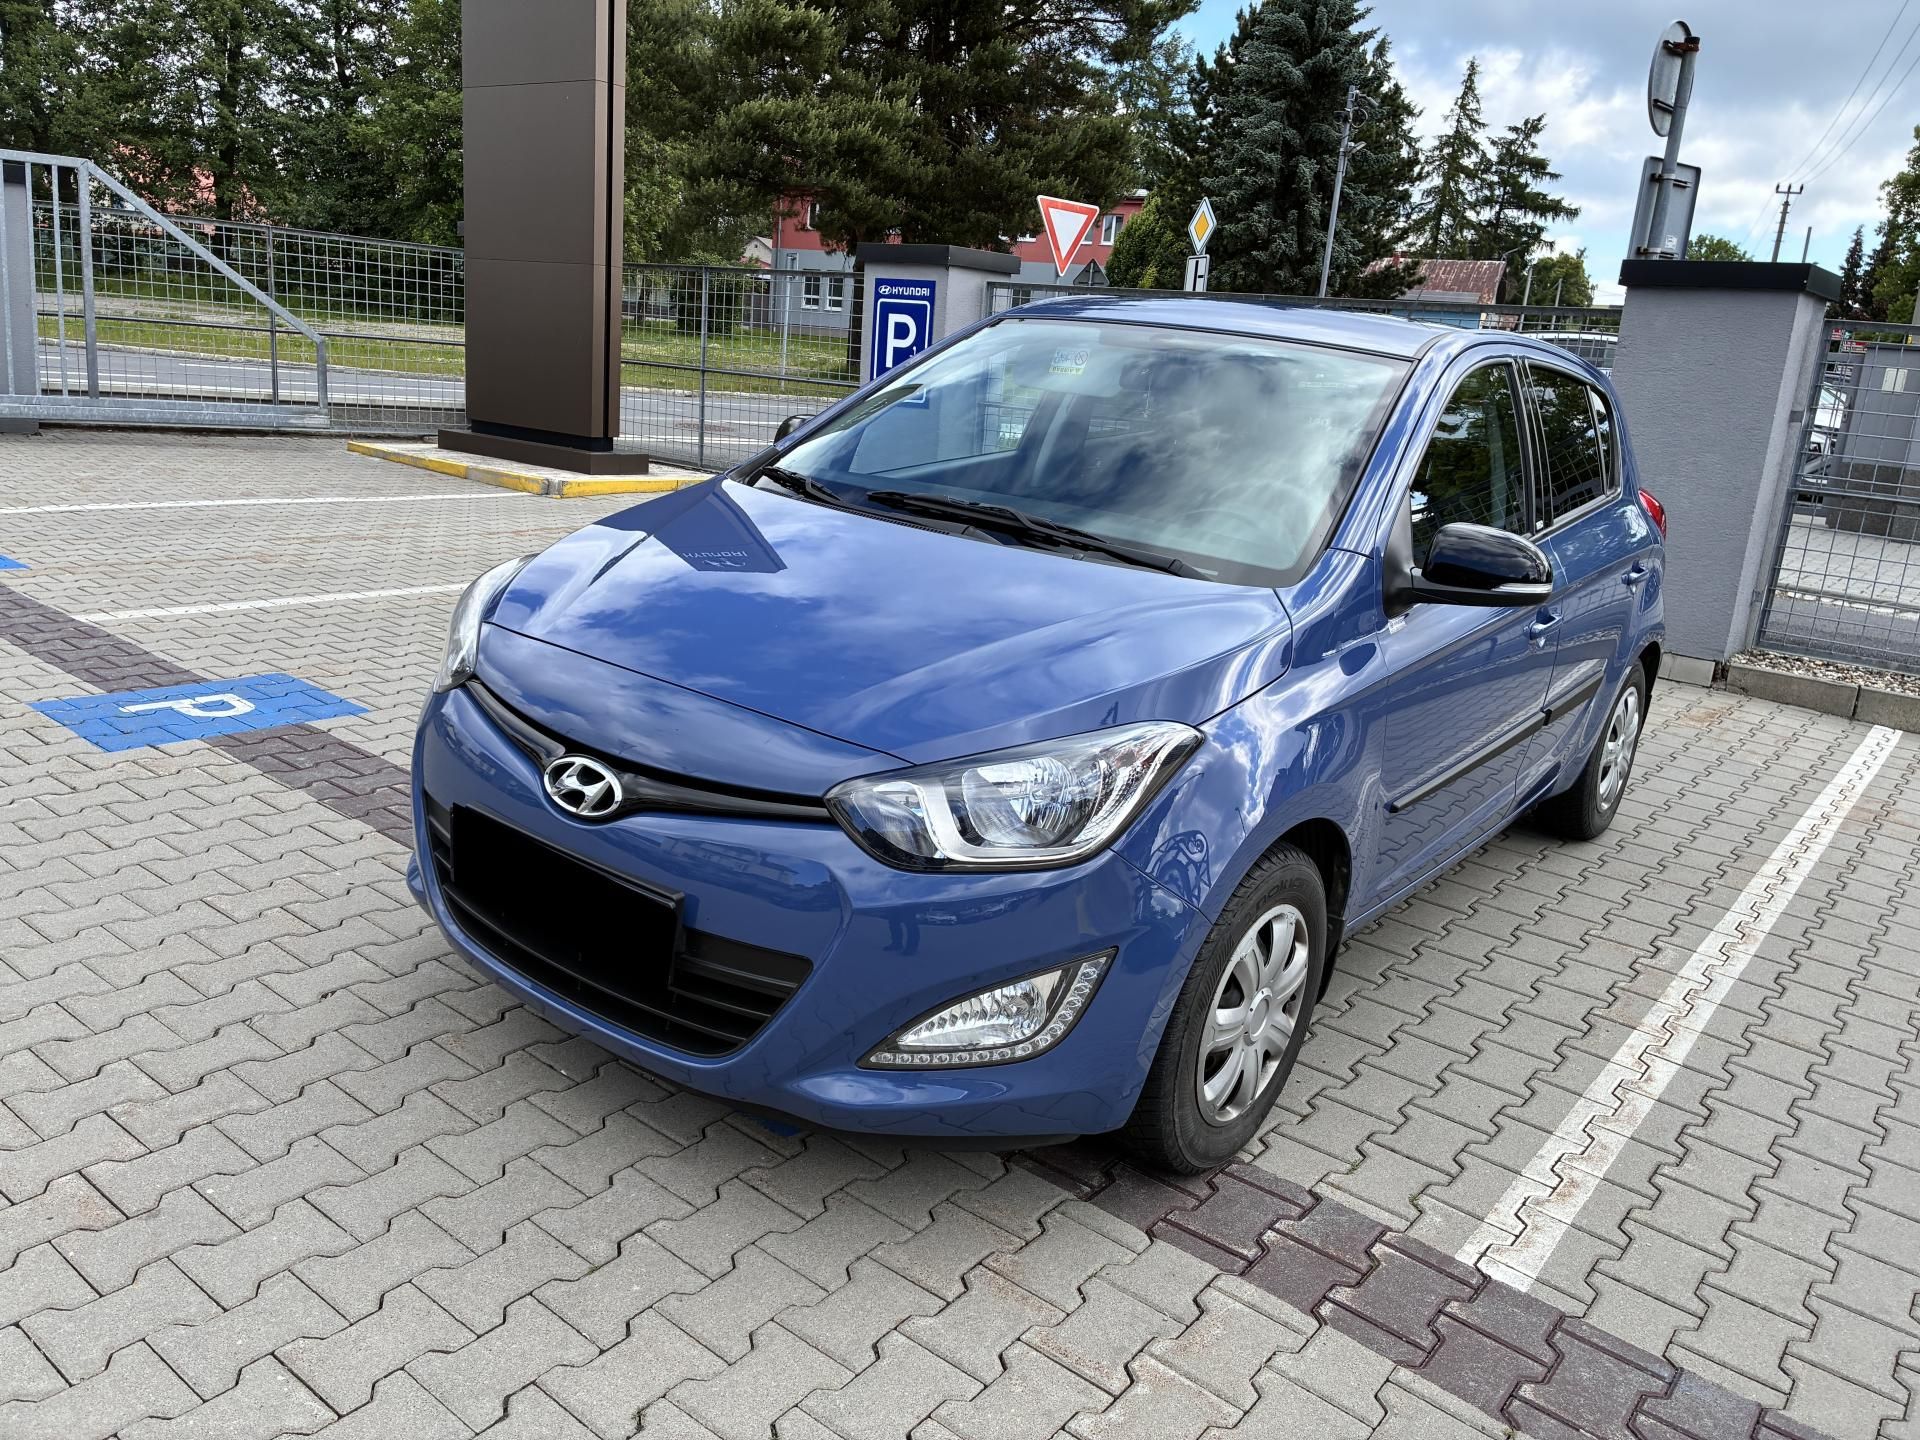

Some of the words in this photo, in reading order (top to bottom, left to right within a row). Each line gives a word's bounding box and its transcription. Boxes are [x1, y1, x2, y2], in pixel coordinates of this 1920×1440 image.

[892, 286, 930, 297] HYUNDAI
[885, 313, 917, 368] P
[119, 692, 256, 718] P
